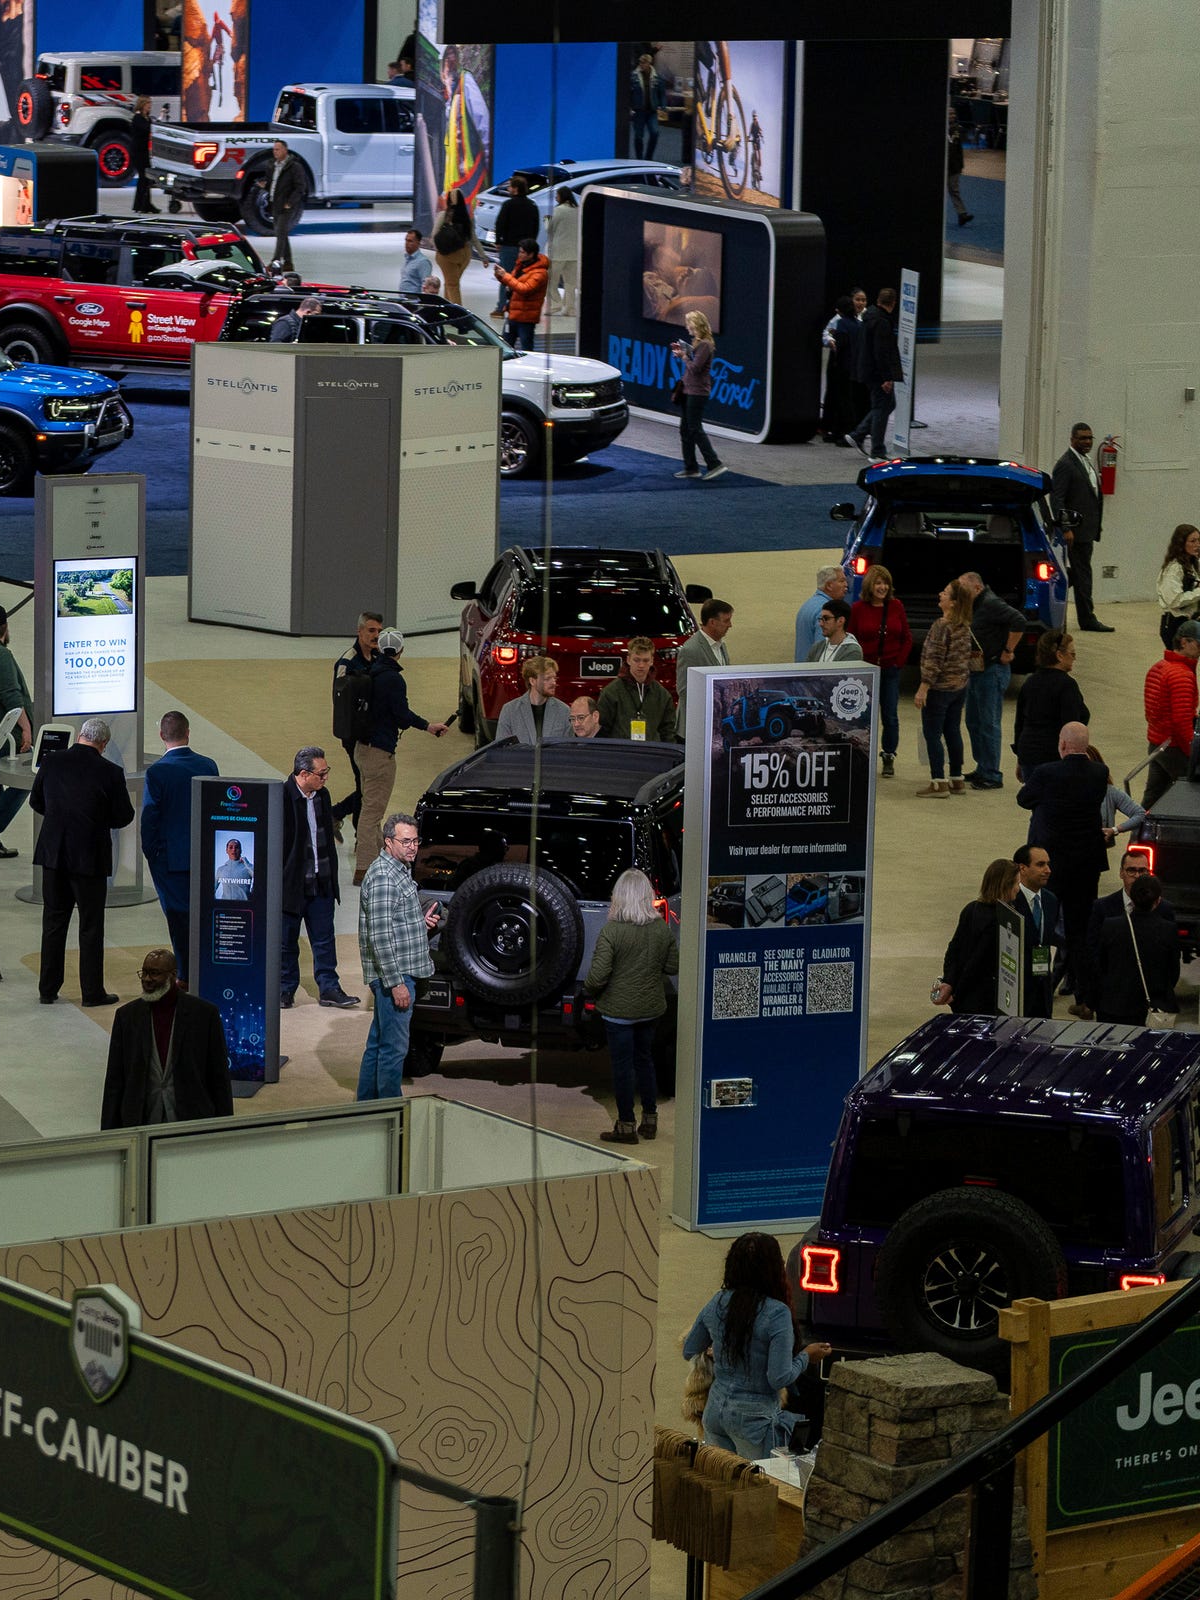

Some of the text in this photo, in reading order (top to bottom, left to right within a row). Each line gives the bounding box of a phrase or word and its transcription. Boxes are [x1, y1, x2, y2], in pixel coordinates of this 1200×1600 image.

[68, 317, 111, 328] Google Maps
[147, 313, 196, 326] Street View
[608, 334, 667, 390] READY
[207, 377, 279, 393] STELLANTIS
[317, 380, 380, 389] STELLANTIS
[414, 382, 483, 396] STELLANTIS
[709, 357, 757, 411] Ford
[63, 638, 127, 649] ENTER TO WIN
[64, 655, 125, 669] $100,000
[588, 661, 614, 673] Jeep
[841, 688, 860, 696] Jeep
[741, 752, 790, 790] 15%
[751, 792, 829, 805] SELECT ACCESSORIES
[746, 807, 752, 818] &
[753, 806, 807, 818] PERFORMANCE
[729, 842, 847, 857] Visit your dealer for more information
[718, 952, 757, 964] WRANGLER
[764, 948, 805, 960] SEE SOME OF
[812, 947, 851, 959] GLADIATOR
[764, 959, 805, 971] THE MANY
[763, 971, 804, 982] ACCESSORIES
[763, 982, 804, 994] AVAILABLE FOR
[762, 994, 797, 1006] WRANGLER
[762, 1005, 803, 1017] GLADIATOR
[1115, 1449, 1172, 1469] THERE'S
